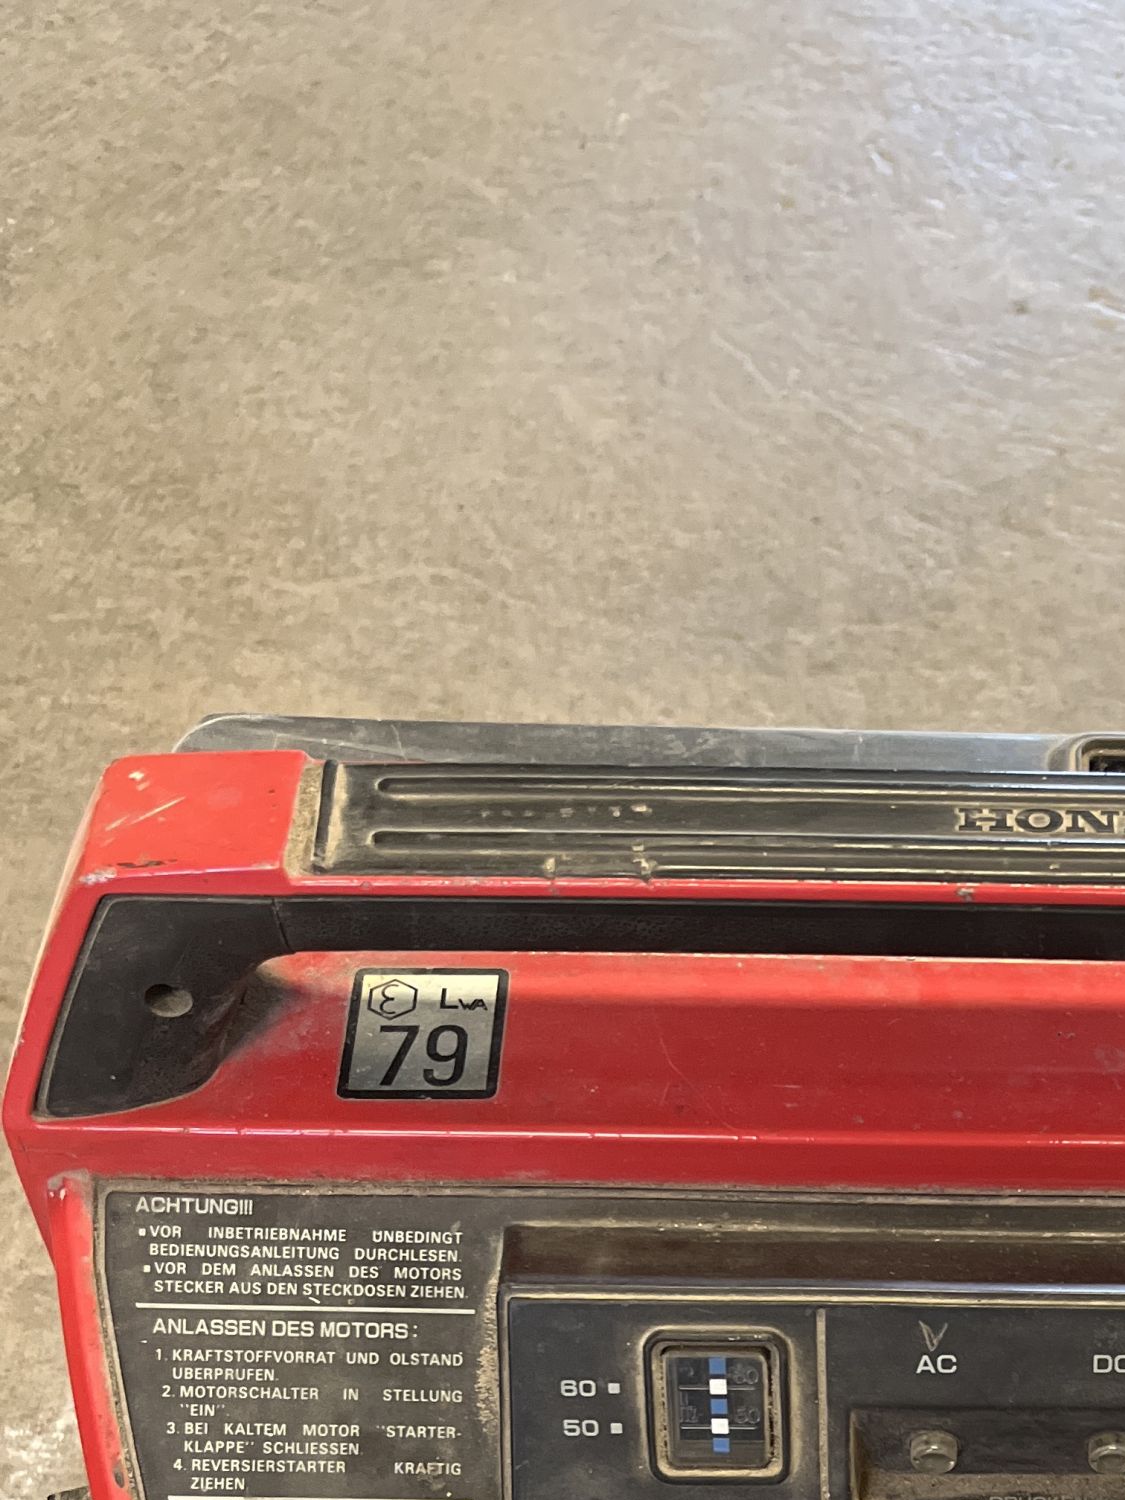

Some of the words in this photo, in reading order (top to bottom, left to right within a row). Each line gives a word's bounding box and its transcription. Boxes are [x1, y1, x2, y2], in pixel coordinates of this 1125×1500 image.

[379, 1024, 468, 1087] 79
[150, 1225, 182, 1239] VOR
[208, 1226, 347, 1242] INBETRIEBNAHME
[149, 1243, 340, 1260] BEDIENUNGSANLEITUNG
[354, 1247, 462, 1263] DURCHLESEN.
[154, 1261, 187, 1275] VOR
[202, 1263, 236, 1276] DEM
[250, 1264, 335, 1279] ANLASSEN
[348, 1265, 379, 1279] DES
[394, 1266, 462, 1281] MOTORS
[153, 1280, 225, 1294] STECKER
[228, 1282, 262, 1296] AUS
[266, 1283, 298, 1296] DEN
[302, 1283, 406, 1299] STECKDOSEN
[410, 1285, 469, 1299] ZIEHEN.
[152, 1318, 267, 1337] ANLASSEN
[271, 1321, 315, 1338] DES
[155, 1348, 169, 1362] 1.
[172, 1348, 336, 1364] KRAFTSTOFFVORRAT
[346, 1352, 380, 1365] UND
[915, 1354, 958, 1374] AC
[161, 1385, 176, 1398] 2.
[179, 1385, 319, 1401] MOTORSCHALTER
[343, 1388, 359, 1401] IN
[382, 1388, 463, 1403] STELLUNG
[560, 1379, 597, 1398] 60
[166, 1421, 180, 1435] 3.
[184, 1422, 209, 1435] BEI
[224, 1422, 287, 1437] KALTEM
[302, 1424, 360, 1437] MOTOR
[562, 1419, 600, 1437] 50
[173, 1458, 187, 1472] 4.
[191, 1458, 346, 1474] REVERSIERSTARTER
